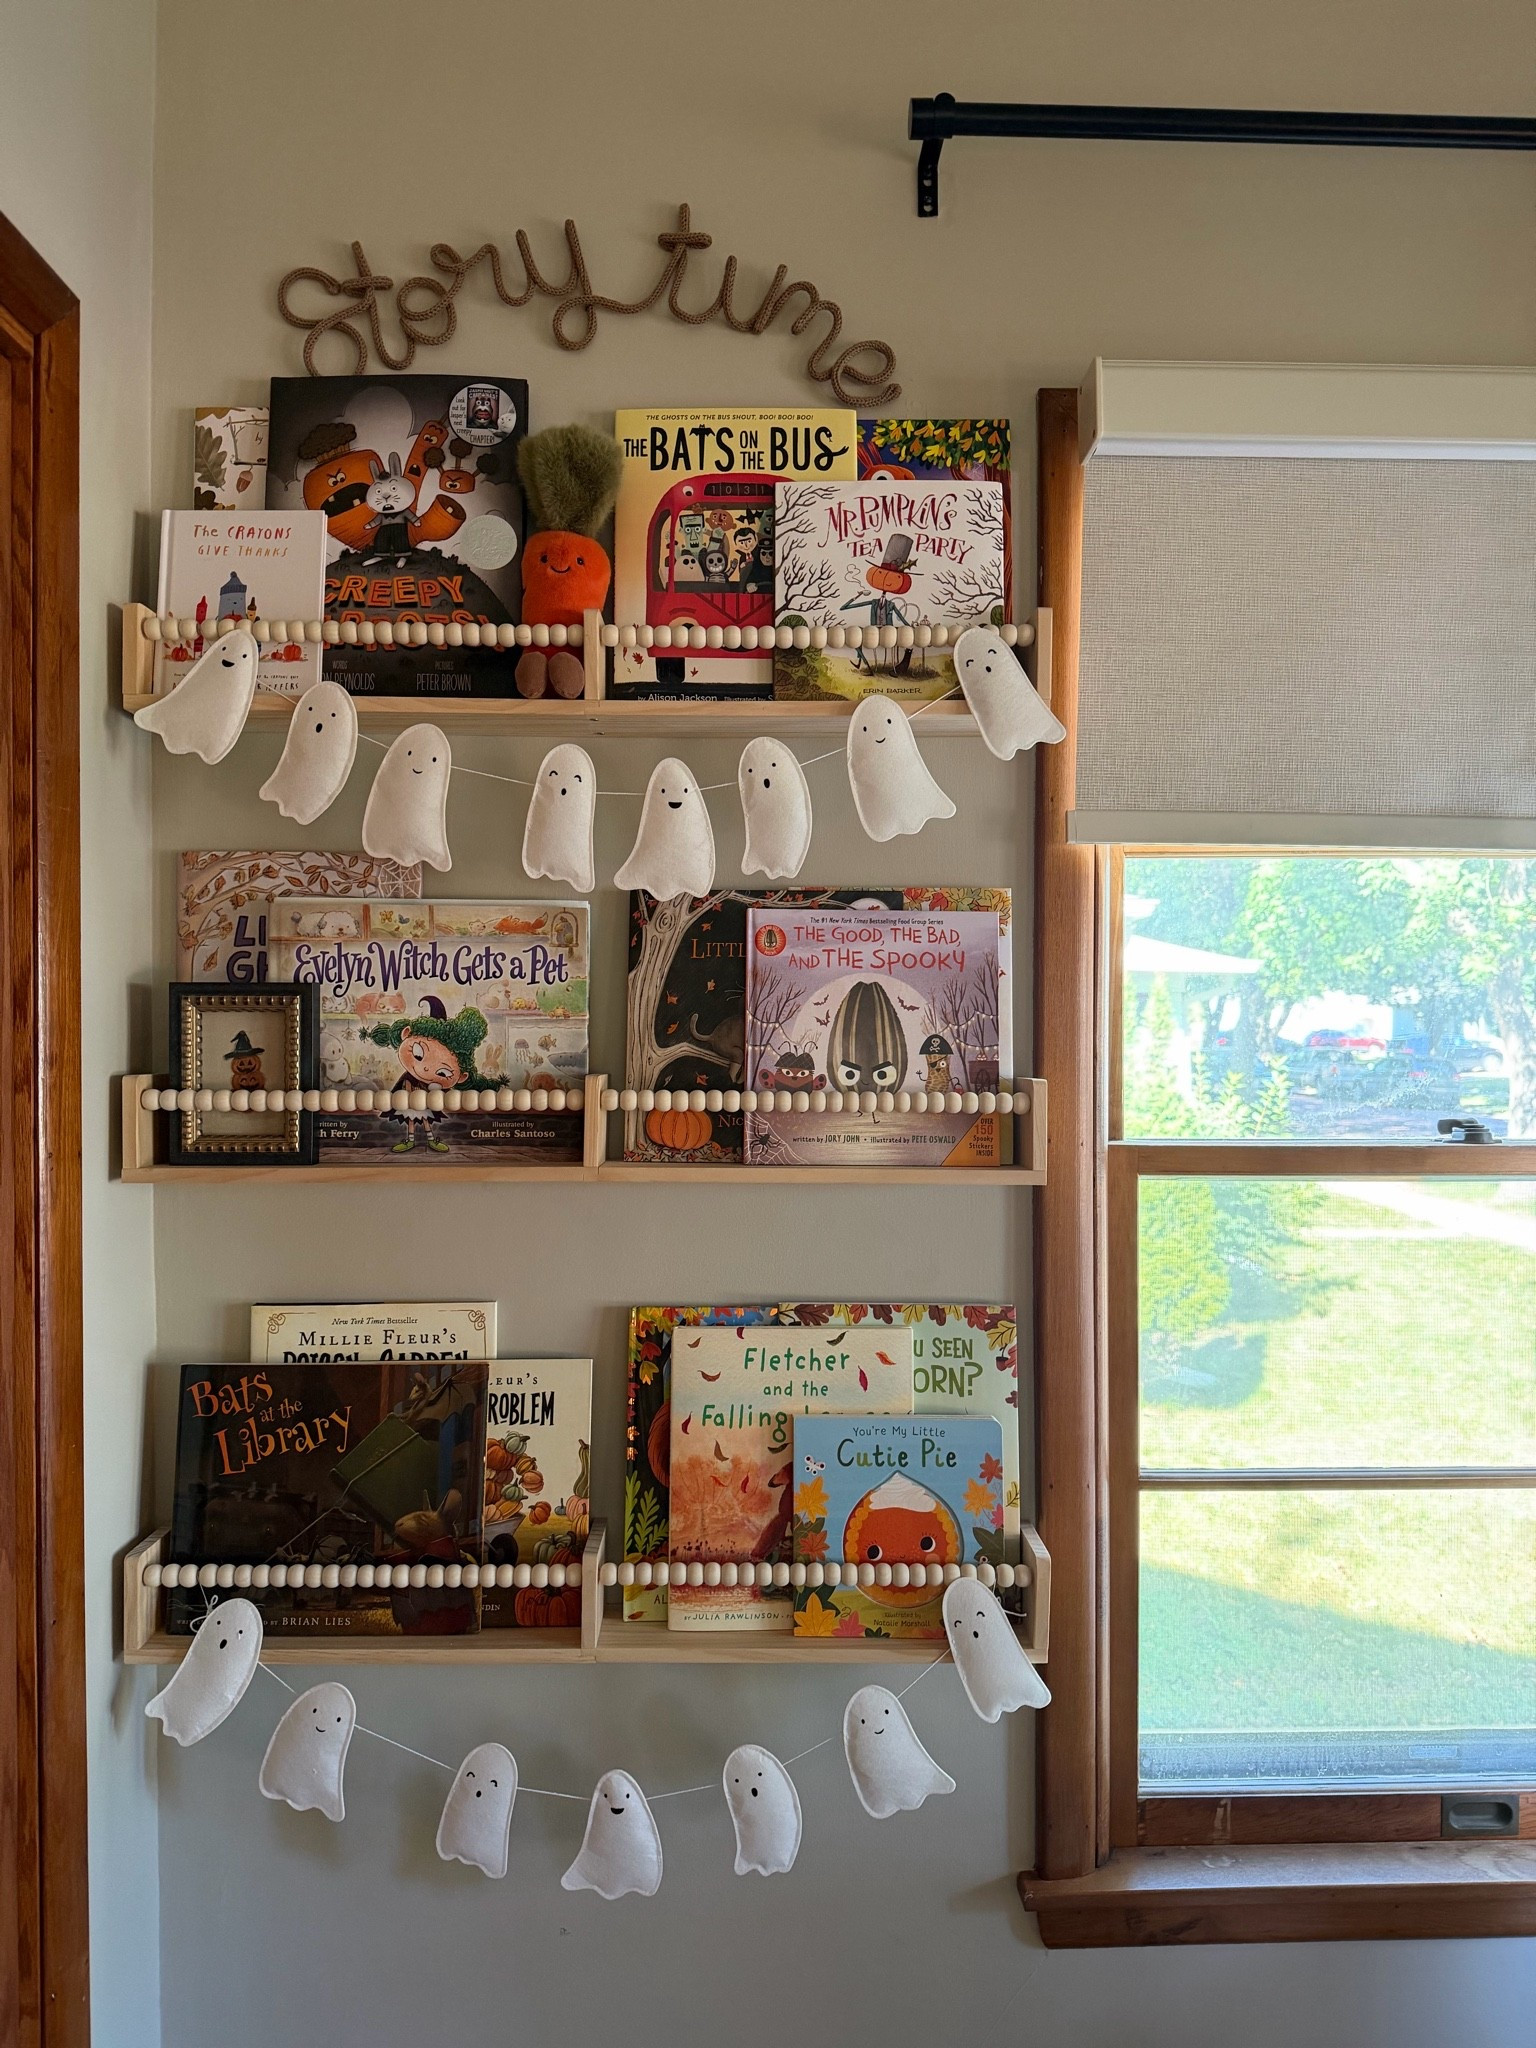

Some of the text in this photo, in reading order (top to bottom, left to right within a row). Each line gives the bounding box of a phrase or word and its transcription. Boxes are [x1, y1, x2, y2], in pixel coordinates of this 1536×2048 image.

[623, 423, 849, 472] THE BATS ON THE BUS
[194, 525, 291, 540] The CRAYONS
[817, 501, 865, 548] MR.
[198, 545, 288, 557] GIVE THANKS
[847, 533, 974, 565] TEA PARTY
[325, 576, 464, 607] CREEPY
[417, 673, 471, 691] PETER BROWN
[648, 693, 677, 702] Alison
[680, 693, 718, 702] Jackson
[911, 918, 927, 926] Group
[793, 926, 826, 943] THE
[831, 926, 885, 946] GOOD,
[890, 927, 922, 945] THE
[927, 927, 961, 947] BAD,
[293, 939, 569, 998] Evelyn Witch Gets a Pet
[788, 948, 965, 975] AND THE SPOOKY
[339, 1121, 348, 1129] by
[470, 1129, 556, 1138] Charles Santoso
[526, 1121, 535, 1129] by
[975, 1124, 993, 1135] 150
[330, 1129, 360, 1140] Ferry
[816, 1136, 824, 1144] by
[824, 1134, 842, 1143] JORY
[842, 1134, 860, 1143] JOHN
[903, 1136, 910, 1145] by
[911, 1135, 927, 1144] PETE
[928, 1135, 956, 1144] OSWALD
[973, 1135, 994, 1143] Spooky
[969, 1142, 994, 1150] Stickers
[366, 1316, 386, 1325] Times
[386, 1316, 419, 1325] Bestseller
[298, 1327, 457, 1346] MILLIE FLEUR'S
[931, 1337, 973, 1360] SEEN
[744, 1347, 850, 1372] Fletcher
[489, 1372, 538, 1386] EUR'S
[913, 1361, 983, 1398] ORN?
[186, 1371, 273, 1418] Bats
[763, 1380, 829, 1397] and the
[259, 1397, 304, 1423] at the
[488, 1391, 555, 1426] ROBLEM
[702, 1403, 788, 1443] Falling
[852, 1425, 946, 1438] You're My Little
[213, 1405, 353, 1476] Library
[837, 1438, 957, 1468] Cutie Pie
[282, 1617, 320, 1626] BRIAN
[325, 1617, 351, 1626] LIES
[873, 1619, 899, 1627] Natalie
